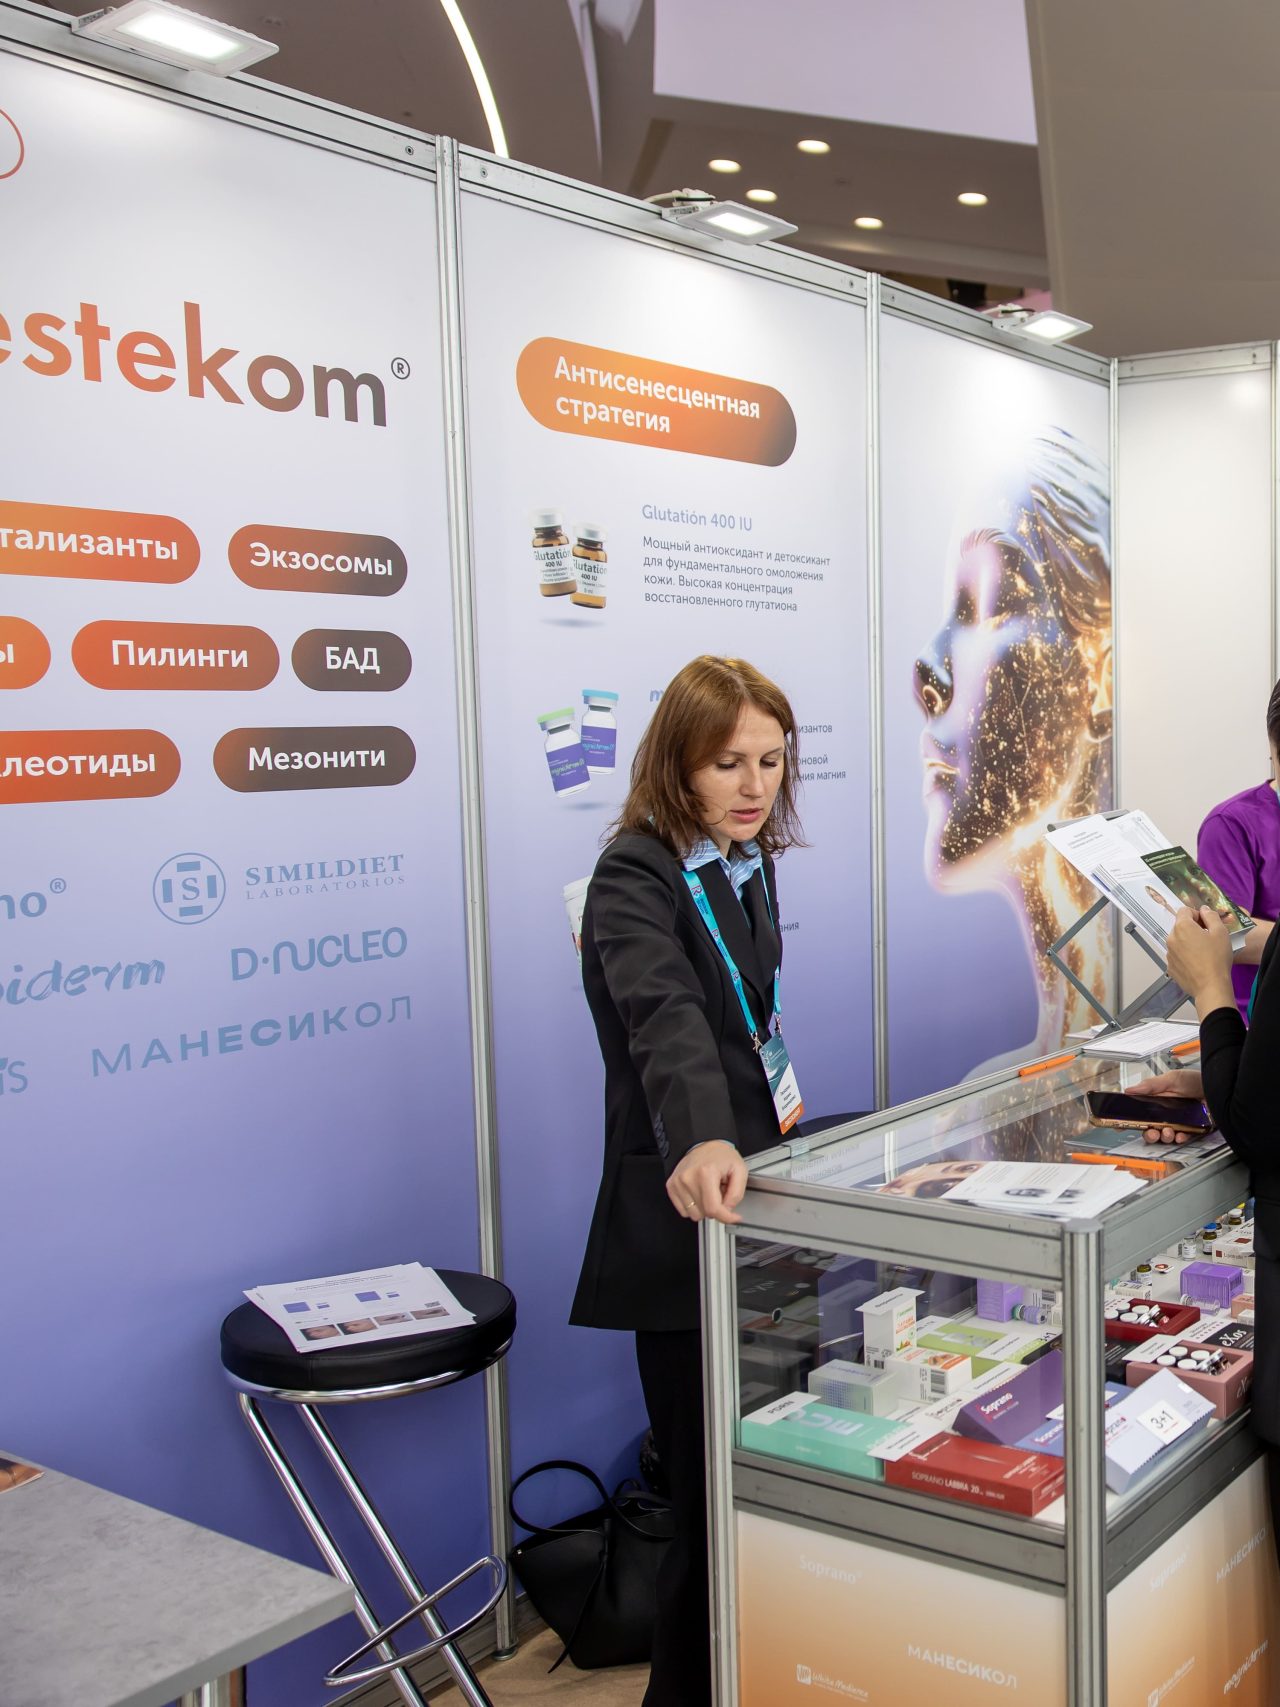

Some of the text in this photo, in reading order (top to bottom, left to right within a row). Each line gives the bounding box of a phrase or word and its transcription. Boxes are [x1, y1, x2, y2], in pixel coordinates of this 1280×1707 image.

[0, 301, 411, 427] stekom®
[555, 356, 760, 419] Антисенесцентная
[556, 396, 671, 433] стратегия
[711, 513, 736, 529] 400
[739, 516, 753, 531] IU
[249, 542, 393, 576] Экзосомы
[643, 536, 831, 567] Мощный антиоксидант и детоксикант
[643, 556, 824, 582] для фундаментального омоложения
[678, 575, 723, 589] Высокая
[725, 581, 793, 595] концентрация
[644, 591, 798, 612] восстановленного глутатиона
[111, 640, 249, 668] Пилинги
[325, 646, 381, 675] БАД
[0, 753, 156, 777] леотиды
[248, 746, 386, 771] Мезонити
[816, 770, 847, 781] магния
[245, 853, 405, 887] SIMILDIET
[245, 875, 406, 901] LABORATORIOS
[91, 995, 412, 1078] МАНЕСИКОЛ
[979, 1392, 1013, 1415] Soprano
[1150, 1410, 1174, 1430] 3+1
[911, 1471, 945, 1486] SOPRANO
[906, 1642, 1019, 1690] МАНЕСИКОЛ
